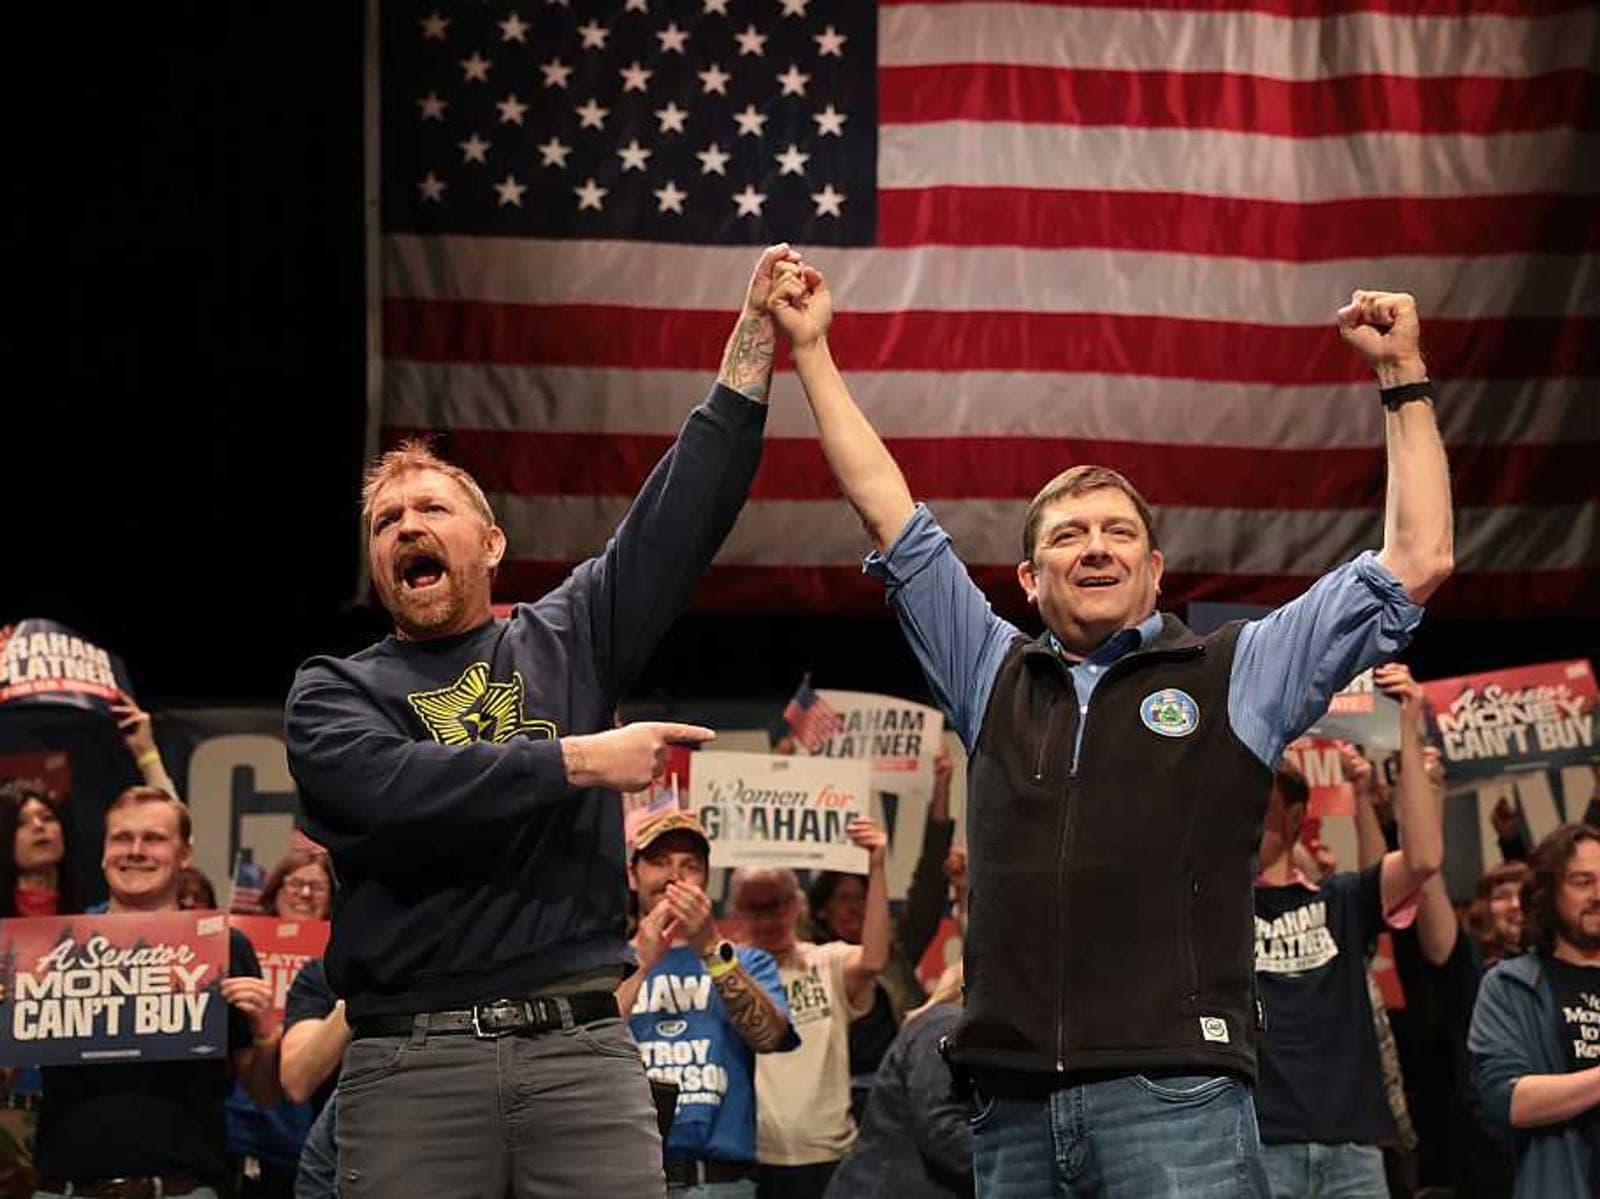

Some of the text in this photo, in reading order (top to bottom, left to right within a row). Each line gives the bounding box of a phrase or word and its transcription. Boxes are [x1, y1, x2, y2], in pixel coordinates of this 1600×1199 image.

[1436, 696, 1585, 734] MONEY
[1443, 715, 1593, 762] CAN'T BUY
[707, 777, 856, 808] Women for
[36, 936, 196, 973] A Senator
[15, 964, 210, 1000] MONEY
[13, 992, 210, 1041] CAN'T BUY
[640, 1039, 711, 1068] TROY
